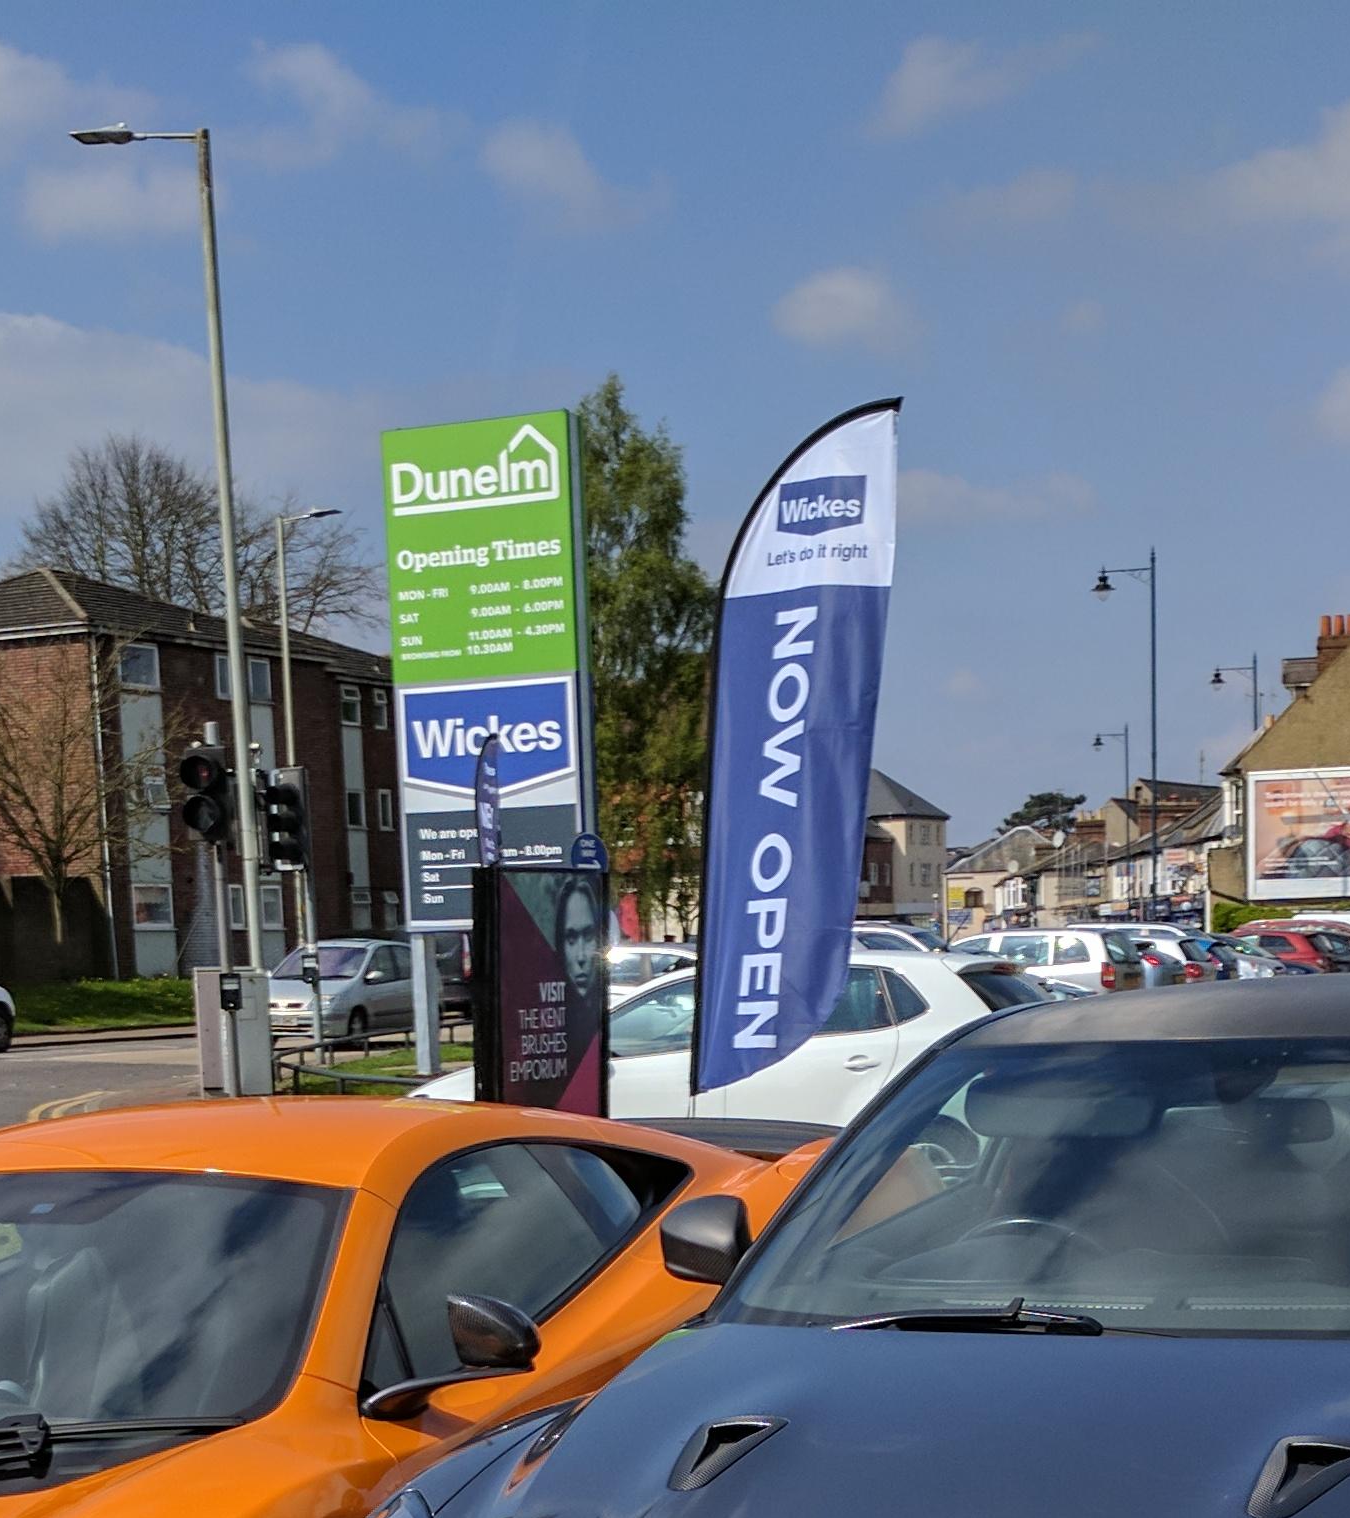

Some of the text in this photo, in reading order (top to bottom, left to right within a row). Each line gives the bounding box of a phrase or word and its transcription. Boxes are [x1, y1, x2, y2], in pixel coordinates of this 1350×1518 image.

[390, 449, 549, 505] Dunelm
[781, 494, 862, 525] Wickes
[397, 539, 561, 573] Opening Times
[766, 543, 868, 567] Let's do it right
[397, 590, 425, 601] MON
[431, 588, 449, 598] FRI
[469, 582, 511, 595] 9.00AM
[522, 576, 564, 590] 8.00PM
[398, 613, 420, 624] SAT
[470, 605, 512, 618] 9.00AM
[523, 599, 565, 613] 6.00PM
[401, 635, 423, 647] SUN
[468, 628, 513, 641] 11.00AM
[524, 623, 566, 636] 4.30PM
[466, 642, 514, 656] 10.30AM
[411, 715, 562, 759] Wickes
[418, 828, 438, 840] We
[439, 829, 457, 839] are
[732, 605, 819, 1050] NOW OPEN
[420, 850, 443, 861] Mon
[451, 849, 466, 860] Fri
[422, 872, 441, 883] Sat
[422, 893, 445, 904] Sun
[539, 981, 566, 1002] VISIT
[518, 1006, 566, 1029] THE KENT
[521, 1032, 568, 1055] BRUSHES
[510, 1058, 567, 1082] EMPORIUM
